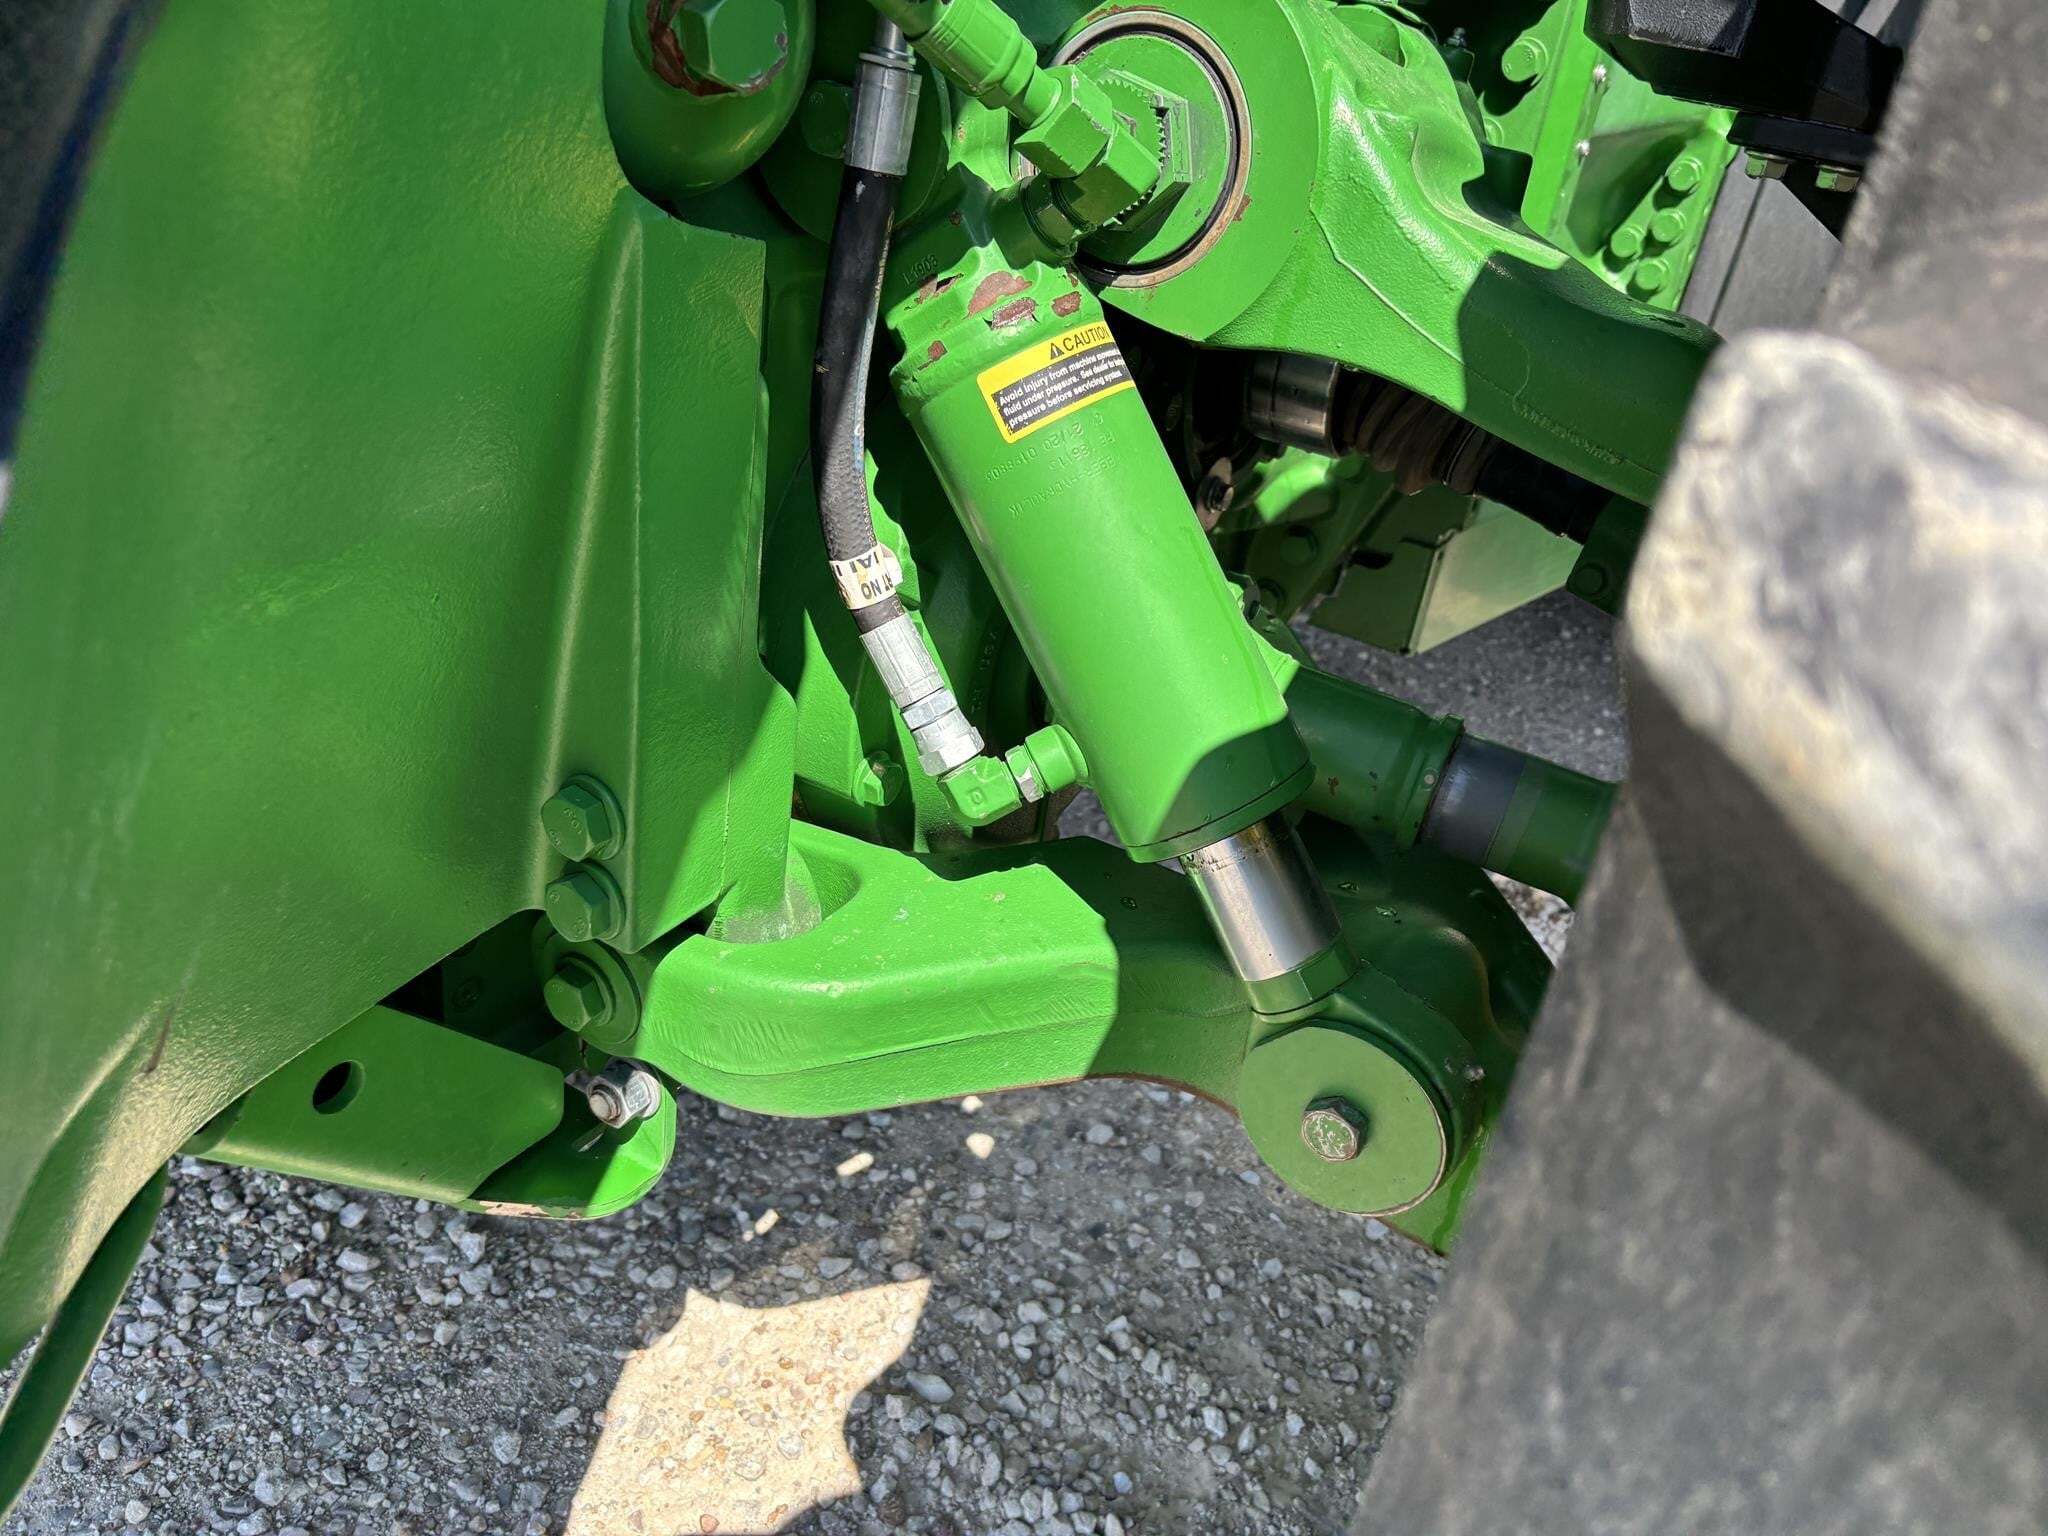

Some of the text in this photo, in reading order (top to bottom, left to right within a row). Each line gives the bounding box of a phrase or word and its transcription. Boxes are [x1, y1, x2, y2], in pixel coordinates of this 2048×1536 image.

[1000, 386, 1023, 406] Avoid
[1049, 366, 1069, 382] from
[1003, 402, 1022, 417] fluid
[1022, 391, 1045, 407] under
[1045, 375, 1080, 397] pressure.
[1009, 403, 1047, 429] pressure
[1046, 389, 1073, 409] before
[1073, 376, 1106, 395] servicing
[860, 578, 882, 600] NO
